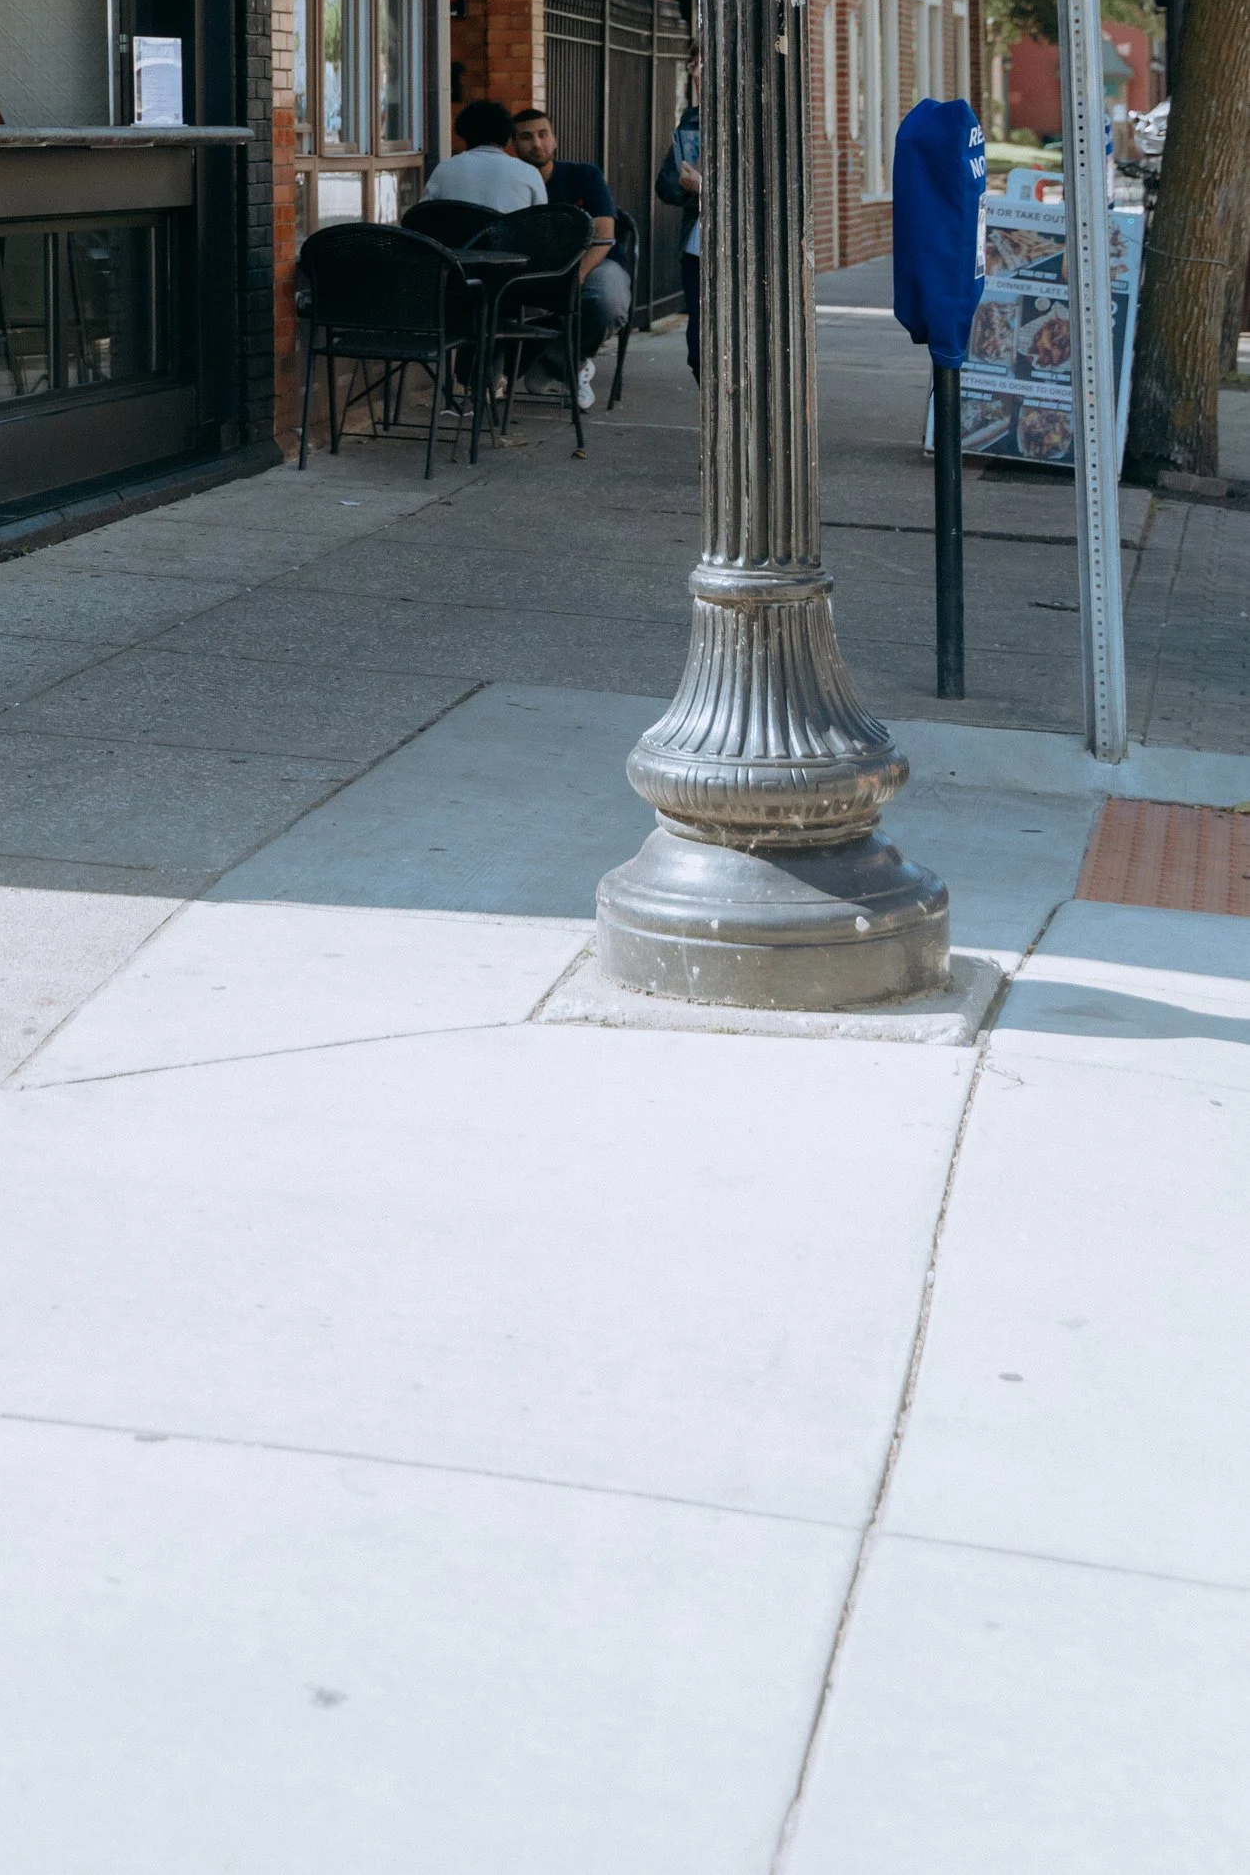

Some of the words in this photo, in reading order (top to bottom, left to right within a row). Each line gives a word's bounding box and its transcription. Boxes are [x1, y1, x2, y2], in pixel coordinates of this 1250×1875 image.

[997, 208, 1012, 218] OR
[1015, 210, 1042, 222] TAKE
[1043, 214, 1065, 224] OUT
[1008, 381, 1034, 393] DONE
[1036, 385, 1048, 394] TO
